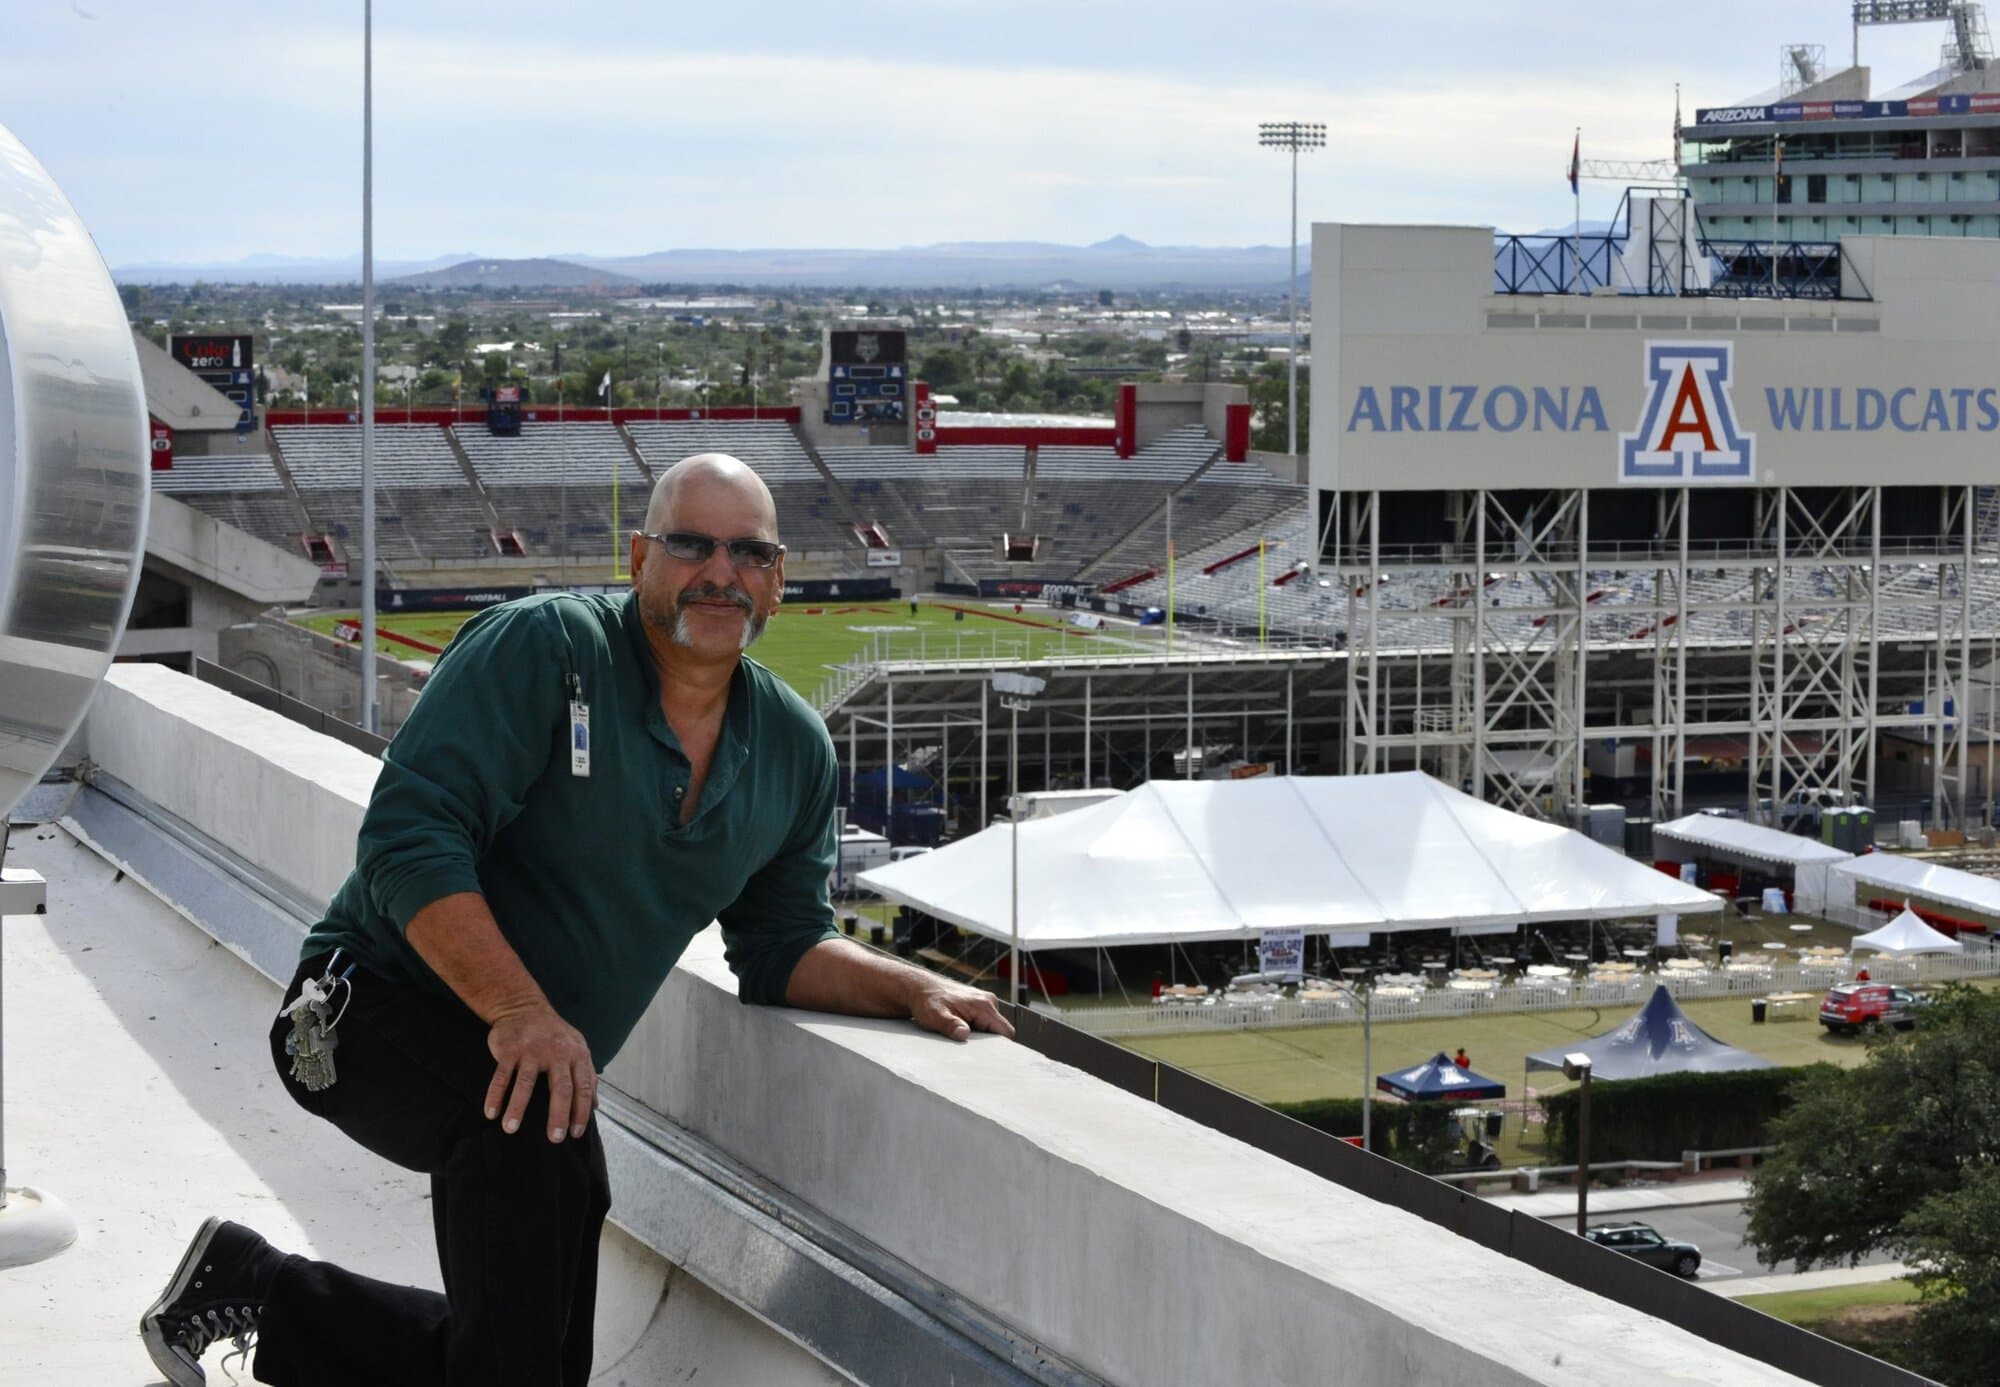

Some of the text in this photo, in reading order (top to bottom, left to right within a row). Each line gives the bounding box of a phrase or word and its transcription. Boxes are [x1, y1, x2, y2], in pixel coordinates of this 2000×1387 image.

[1702, 107, 1766, 122] ARIZONA
[183, 340, 232, 358] Coke
[191, 357, 224, 367] zero
[1346, 340, 2000, 483] ARIZONA A WILDCATS
[464, 593, 507, 602] FOOTBALL
